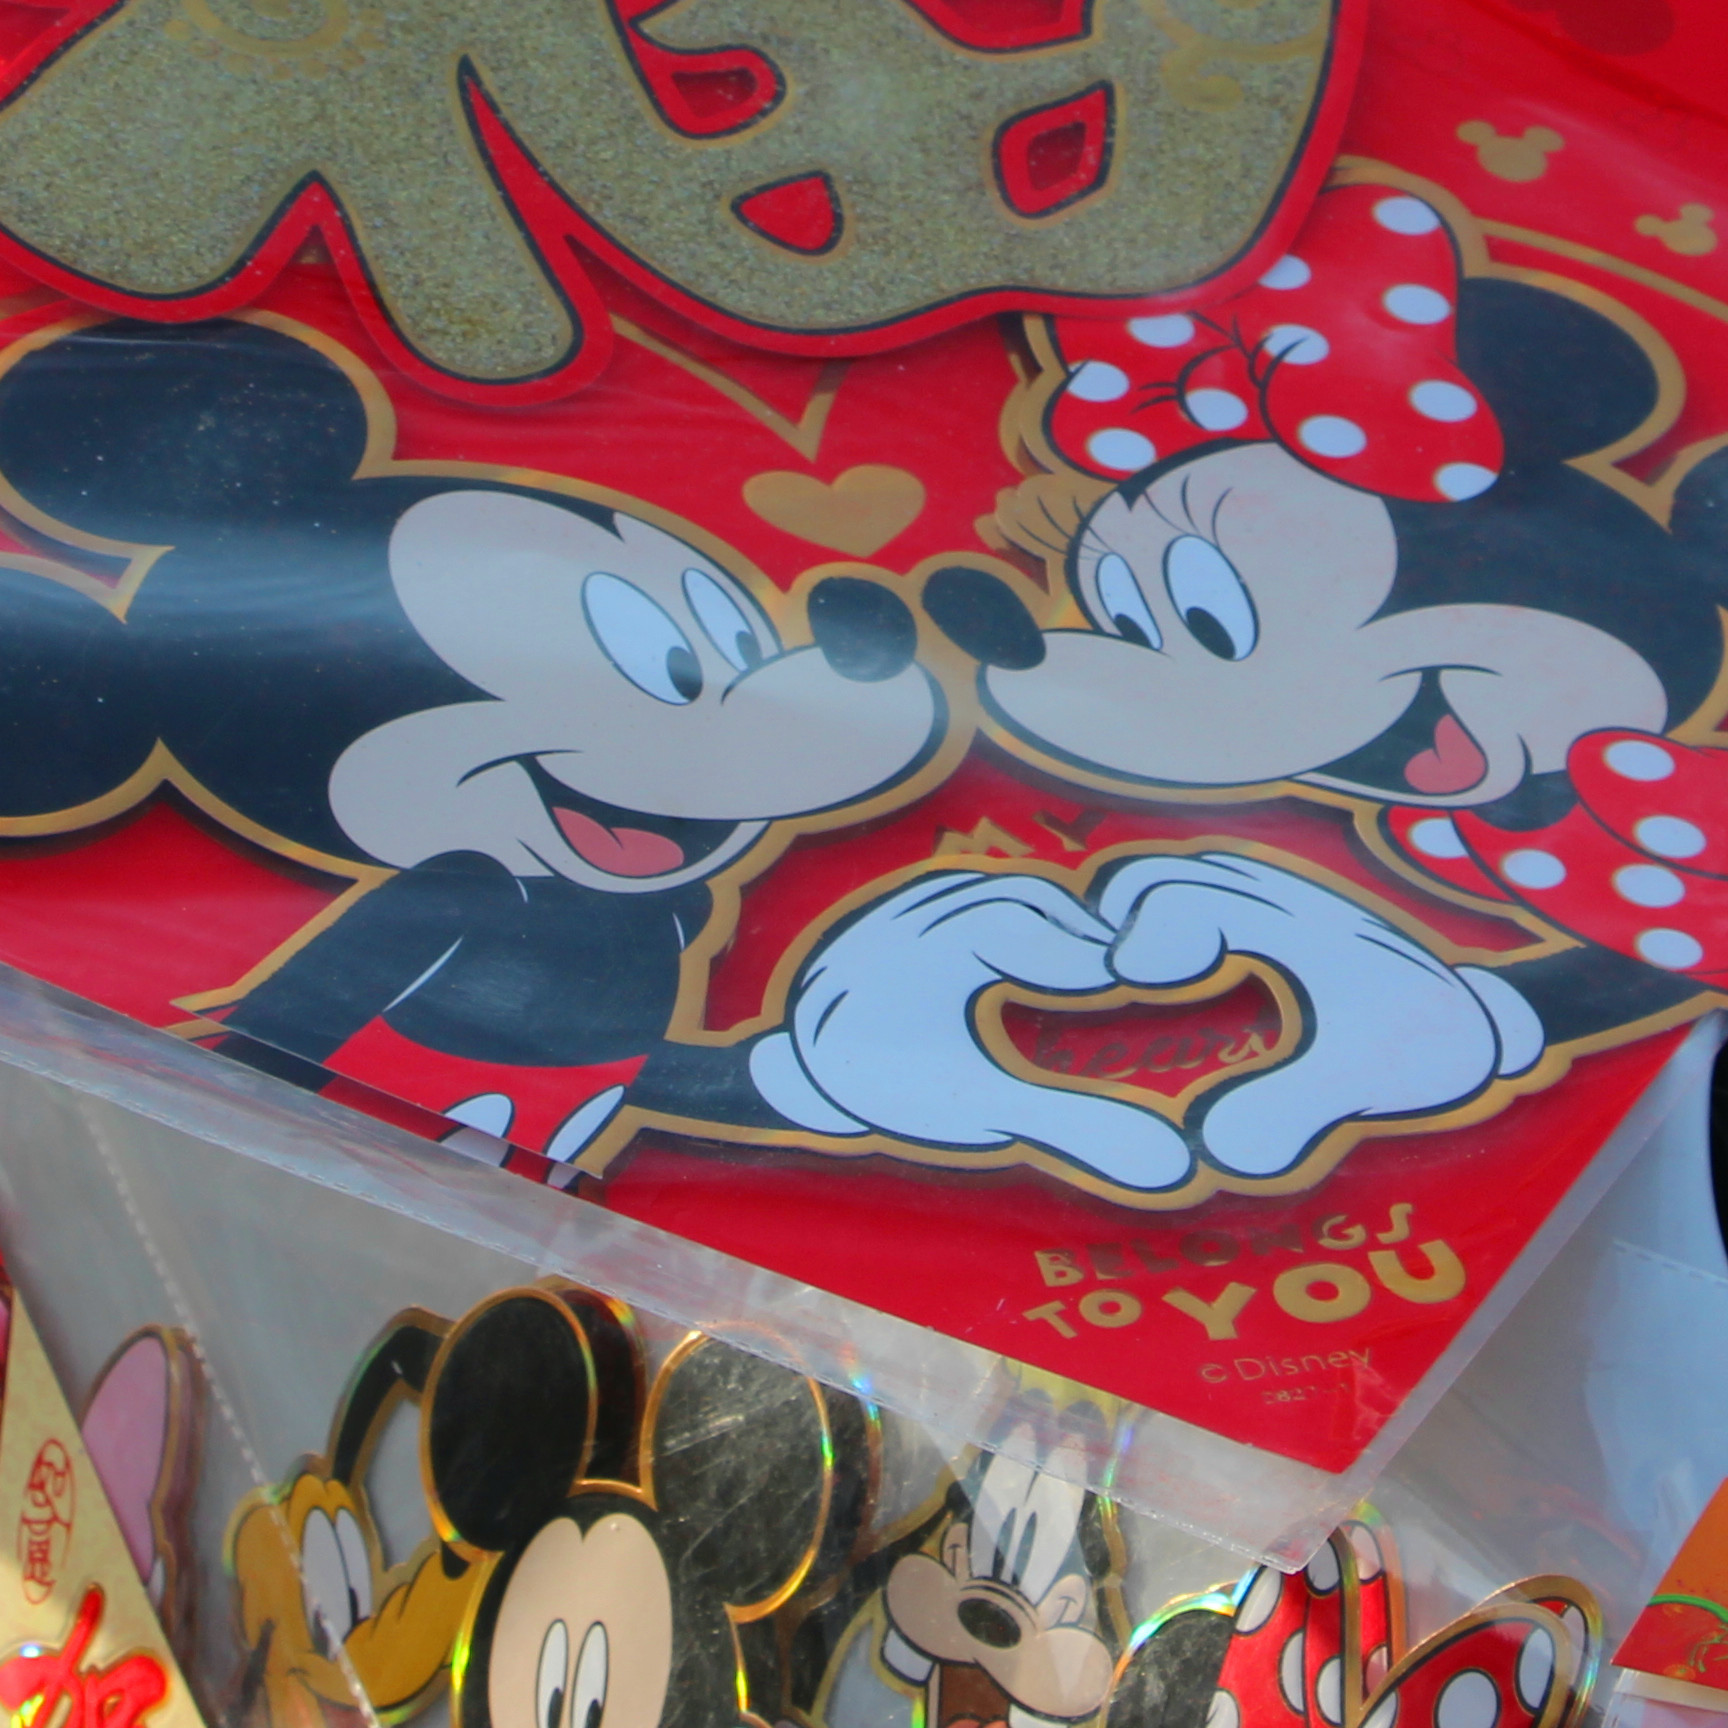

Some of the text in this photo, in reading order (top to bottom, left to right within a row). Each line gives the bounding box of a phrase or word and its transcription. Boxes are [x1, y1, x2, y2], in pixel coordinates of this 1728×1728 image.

[1022, 1238, 1468, 1341] TO YOU
[1034, 1202, 1414, 1292] BELONGS
